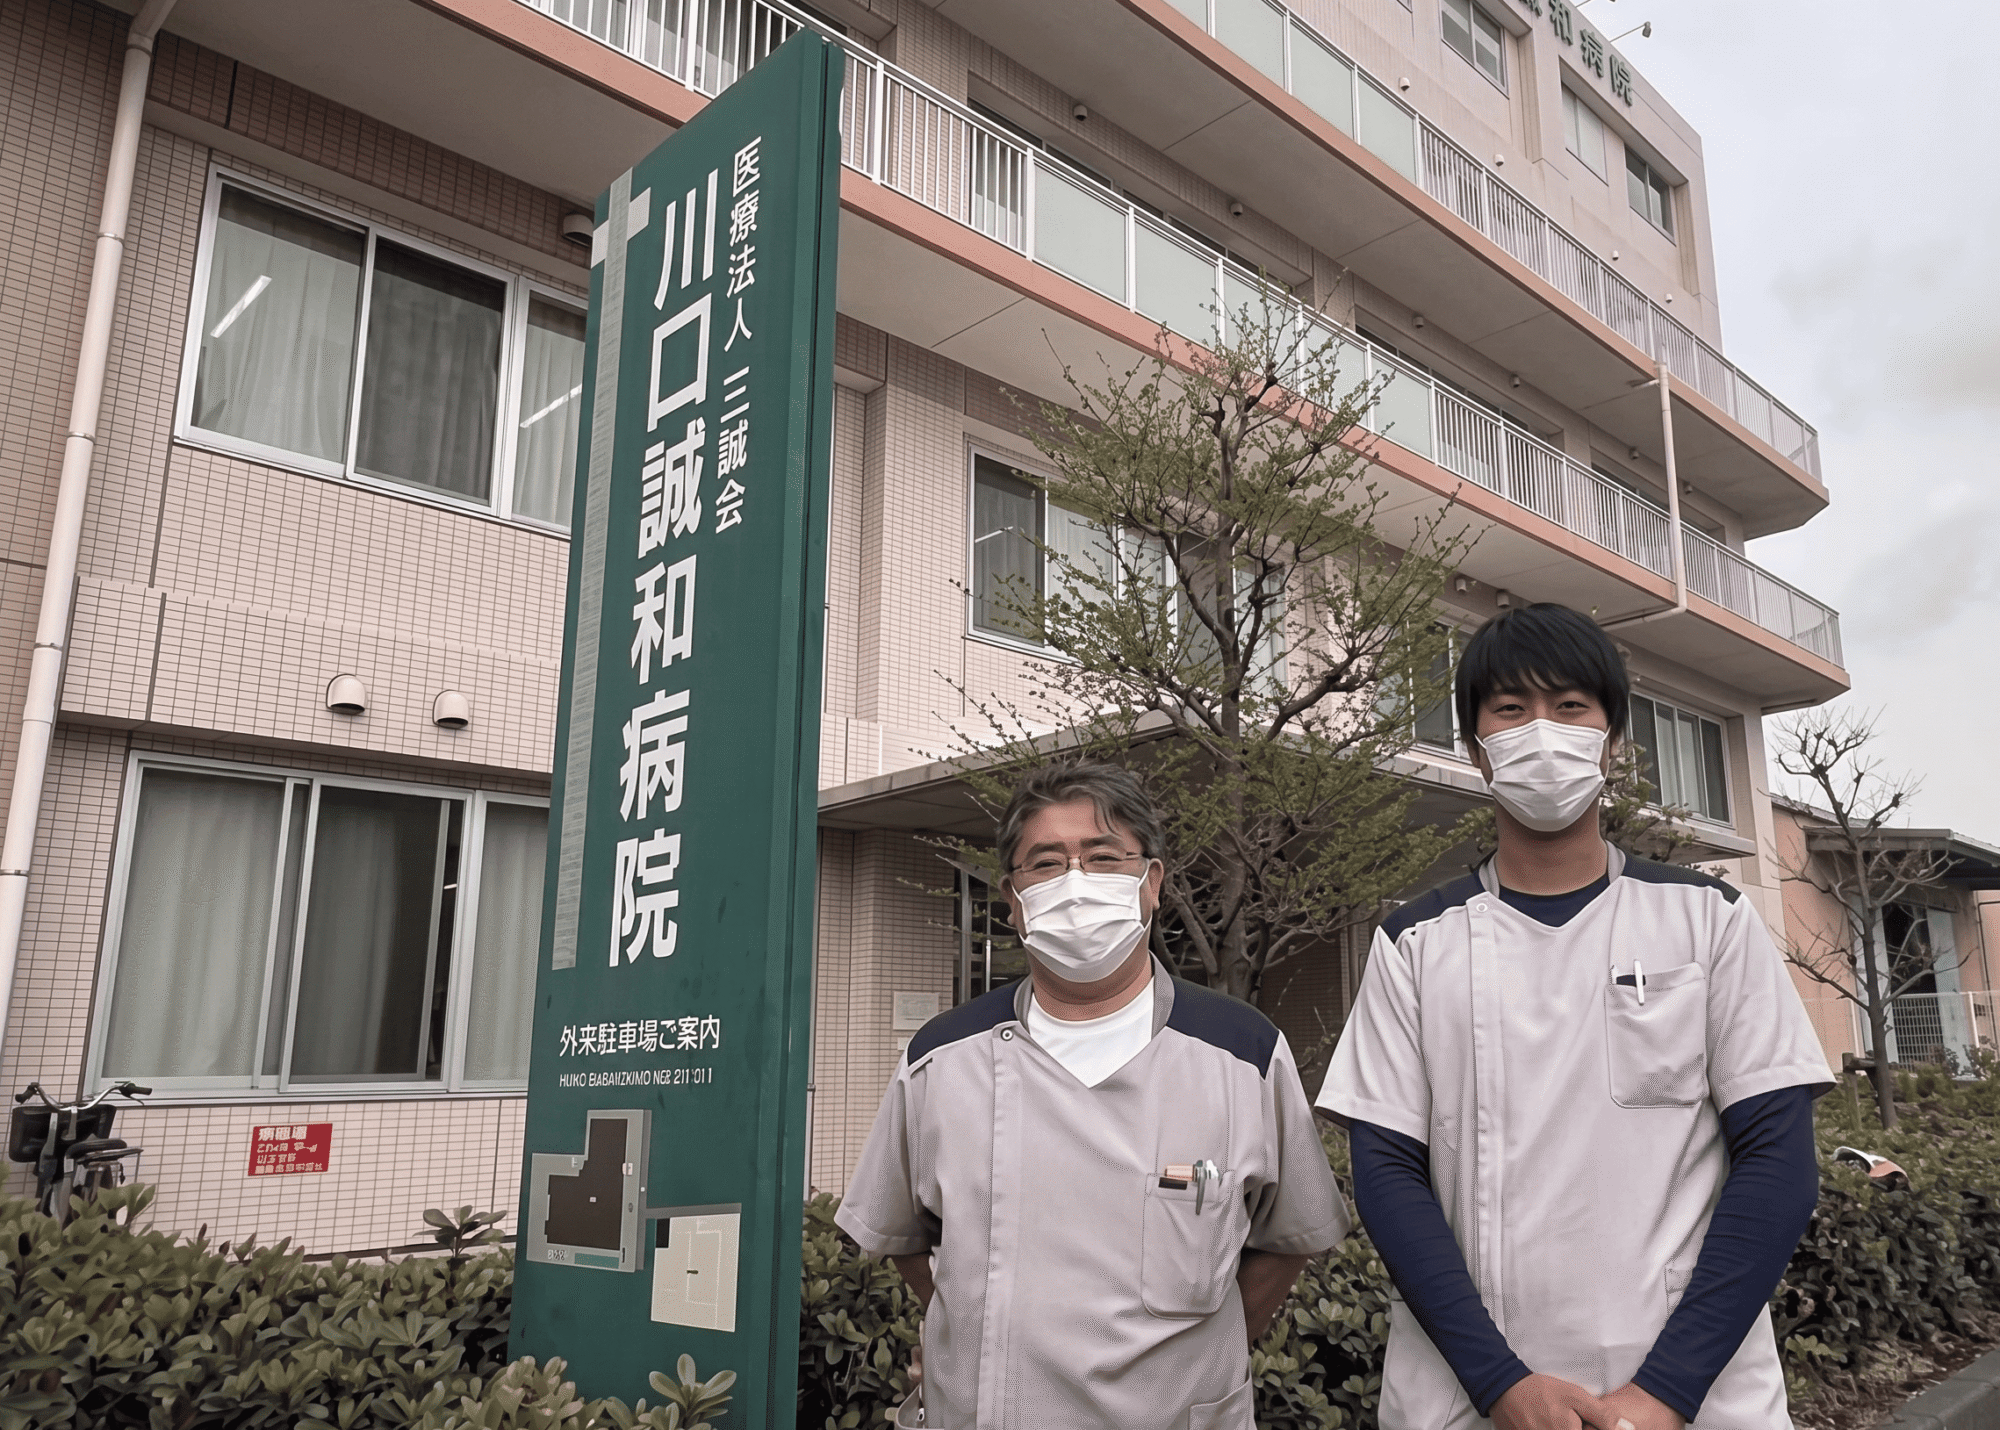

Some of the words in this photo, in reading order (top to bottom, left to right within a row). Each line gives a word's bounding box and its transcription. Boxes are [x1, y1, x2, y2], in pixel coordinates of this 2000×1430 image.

[724, 136, 762, 352] 医療法人
[715, 366, 750, 534] 三誠会
[609, 168, 719, 967] 川口誠和病院
[559, 1014, 721, 1057] 外来駐車場ご案内
